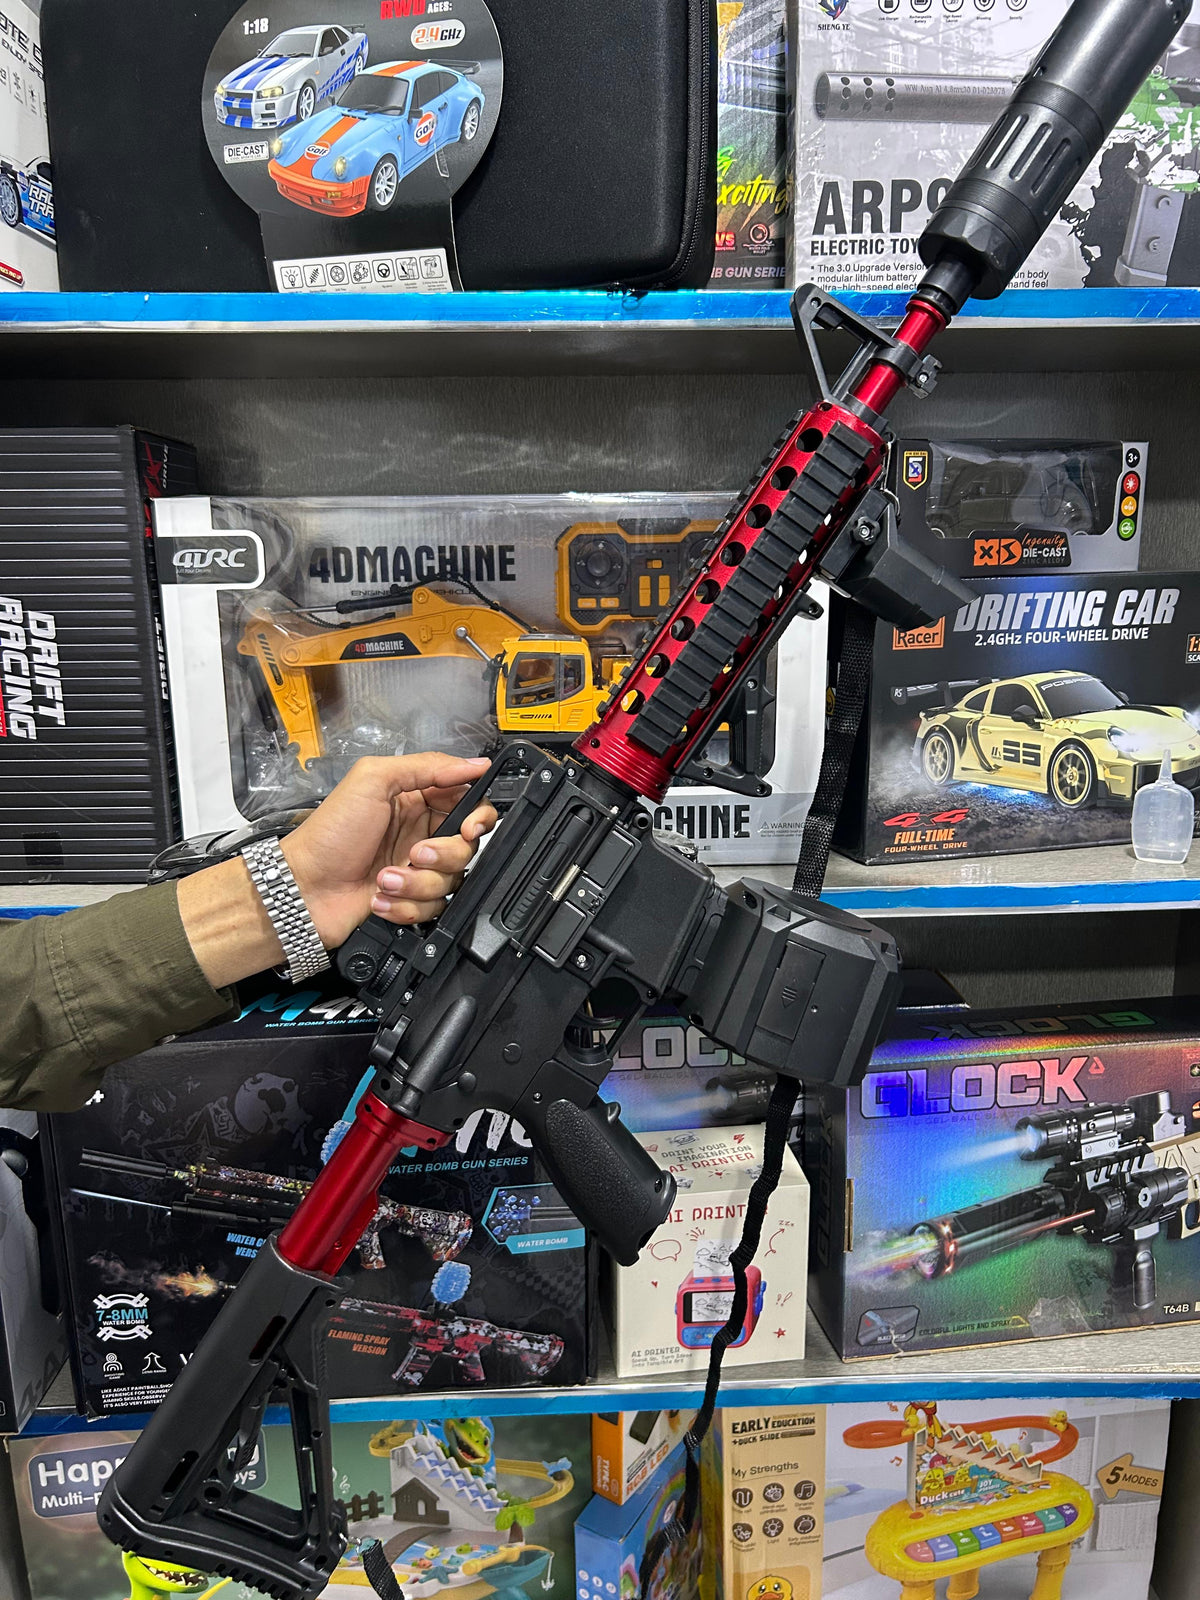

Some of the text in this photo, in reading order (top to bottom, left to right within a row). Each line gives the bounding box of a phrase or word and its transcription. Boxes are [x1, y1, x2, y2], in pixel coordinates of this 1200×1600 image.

[380, 0, 426, 20] RWD
[427, 1, 453, 14] AGES:
[243, 18, 269, 35] 1:18
[222, 144, 265, 157] DIE-CAST
[810, 239, 885, 256] ELECTRIC
[725, 267, 752, 278] GUN
[817, 264, 834, 272] The
[836, 263, 851, 272] 3.0
[853, 263, 891, 274] Upgrade
[1027, 270, 1049, 280] body
[855, 273, 884, 282] lithium
[886, 273, 918, 283] battery
[1032, 280, 1049, 288] feel
[1127, 452, 1138, 463] 3+
[1021, 532, 1066, 549] Ingenuity
[1022, 547, 1068, 558] DIE-CAST
[953, 588, 1181, 632] DRIFTING CAR
[897, 630, 940, 645] Racer
[974, 627, 1150, 647] 2.4GHz FOUR-WHEEL DRIVE
[0, 597, 37, 740] RACING
[28, 610, 66, 726] DRIFT
[893, 828, 956, 845] FULL-TIME
[884, 841, 968, 853] FOUR-WHEEL DRIVE
[860, 1056, 1089, 1119] GLOCK
[677, 1145, 752, 1162] IMAGINATION
[425, 1161, 458, 1171] BOMB
[462, 1159, 486, 1169] GUN
[488, 1156, 529, 1167] SERIES
[669, 1152, 755, 1173] AI PRINTER
[693, 1203, 768, 1221] PRINT
[226, 1232, 257, 1246] WATER
[517, 1237, 569, 1248] WATER BOMB
[96, 1308, 149, 1321] 7-8MM
[1163, 1303, 1190, 1315] T64B
[952, 1324, 975, 1332] LIGHTS
[990, 1320, 1011, 1328] SPRAY
[328, 1329, 391, 1346] FLAMING SPRAY
[352, 1343, 388, 1356] VERSION
[731, 1416, 771, 1434] EARLY
[771, 1416, 816, 1429] EDUCATION
[759, 1432, 780, 1442] SLIDE
[731, 1461, 800, 1479] My Strengths
[1106, 1466, 1159, 1487] 5 MODES
[979, 1478, 993, 1488] JOY
[920, 1489, 966, 1505] Duck cute
